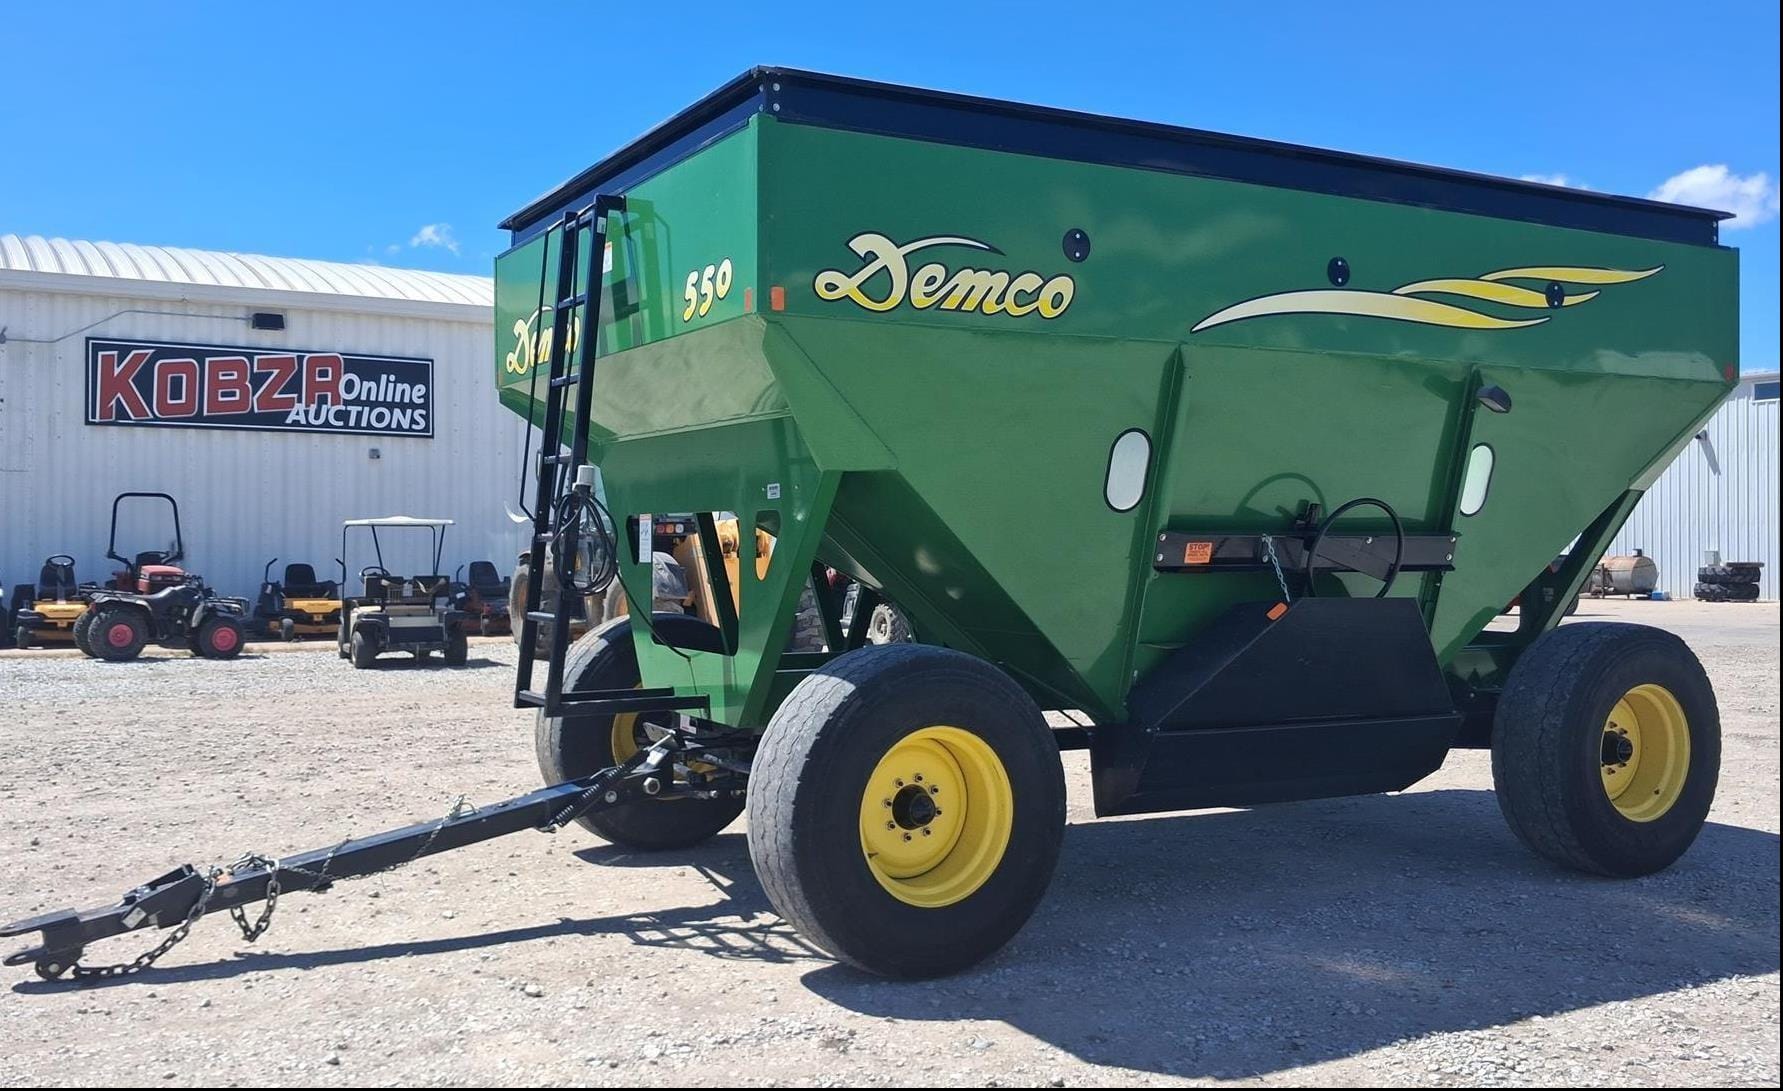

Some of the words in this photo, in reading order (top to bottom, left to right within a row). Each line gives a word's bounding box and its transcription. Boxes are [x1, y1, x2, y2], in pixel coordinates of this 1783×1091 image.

[683, 257, 733, 323] 550
[813, 231, 1075, 320] Demco
[506, 304, 581, 376] Demo
[95, 349, 345, 423] KOBZA
[338, 373, 426, 404] Online
[285, 402, 427, 431] AUCTIONS
